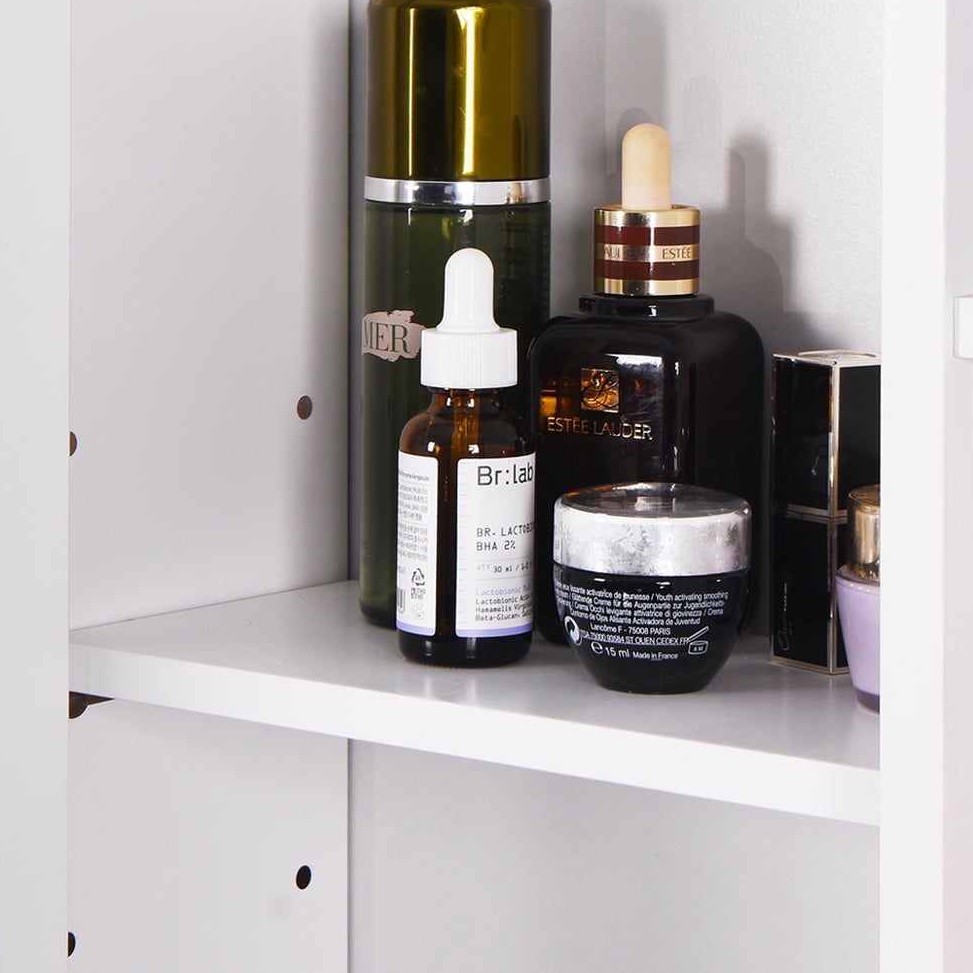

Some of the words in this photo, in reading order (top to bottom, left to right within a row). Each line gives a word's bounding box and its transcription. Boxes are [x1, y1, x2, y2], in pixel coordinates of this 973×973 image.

[593, 421, 653, 440] LAUDER
[477, 461, 534, 486] Br:lab
[476, 527, 496, 538] BR.
[476, 541, 498, 551] BHA
[504, 539, 516, 550] 2%
[493, 565, 502, 573] 30
[475, 596, 518, 605] Lactobionic
[614, 591, 621, 599] de
[655, 593, 673, 601] Youth
[674, 592, 702, 602] activating
[703, 591, 729, 600] smoothing
[475, 605, 512, 613] Hamamelis
[623, 600, 633, 608] die
[634, 601, 671, 611] Augenpartie
[606, 607, 632, 617] levigante
[633, 609, 663, 617] attivatrice
[664, 609, 671, 617] di
[672, 609, 702, 619] giovinezza
[596, 613, 608, 623] Ojos
[632, 617, 665, 625] Activadora
[674, 617, 701, 626] Juventud
[628, 627, 649, 635] 75008
[650, 627, 671, 635] PARIS
[656, 637, 679, 645] CEDEX
[605, 646, 616, 657] 15
[618, 648, 630, 658] ml
[632, 651, 651, 659] Made
[658, 651, 678, 659] France
